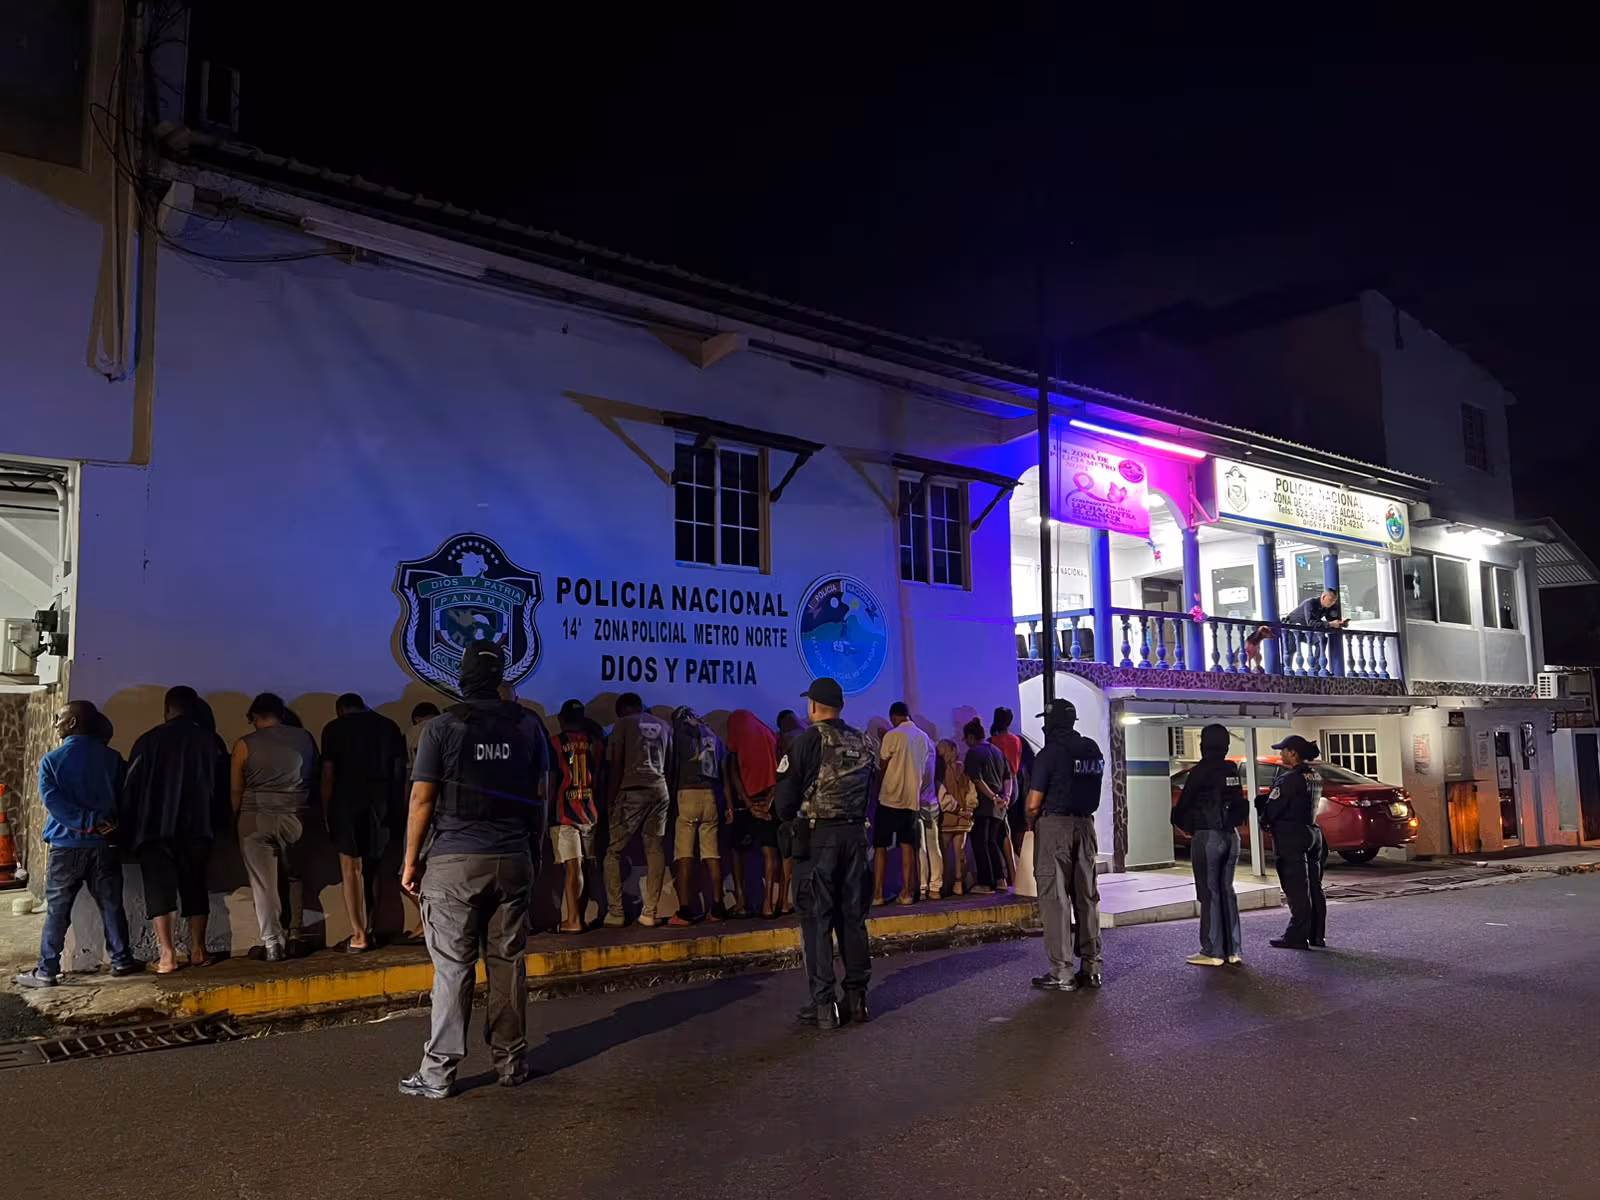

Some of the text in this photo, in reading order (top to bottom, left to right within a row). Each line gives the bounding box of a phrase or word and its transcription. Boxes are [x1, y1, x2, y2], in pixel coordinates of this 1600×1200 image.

[1071, 449, 1096, 461] ZONA
[1097, 455, 1110, 464] DE
[1086, 459, 1116, 472] METRO
[1275, 478, 1313, 497] POLICIA
[1318, 488, 1364, 510] NACIONAL
[1071, 502, 1137, 521] LUCHA CONTRA
[1273, 492, 1292, 506] ZONA
[1293, 497, 1302, 508] DE
[1330, 504, 1339, 516] DE
[1339, 507, 1365, 522] ALCALDE
[1302, 519, 1318, 529] DIOS
[1322, 523, 1343, 533] PATRIA
[431, 577, 522, 601] DIOS Y PATRIA
[556, 576, 789, 617] POLICIA NACIONAL
[440, 594, 506, 610] PANAMA
[594, 618, 629, 642] ZONA
[632, 620, 687, 644] POLICIAL
[693, 623, 740, 647] METRO
[745, 626, 788, 649] NORTE
[435, 653, 462, 673] POLIC
[601, 654, 758, 686] DIOS Y PATRIA
[476, 743, 510, 761] DNAD
